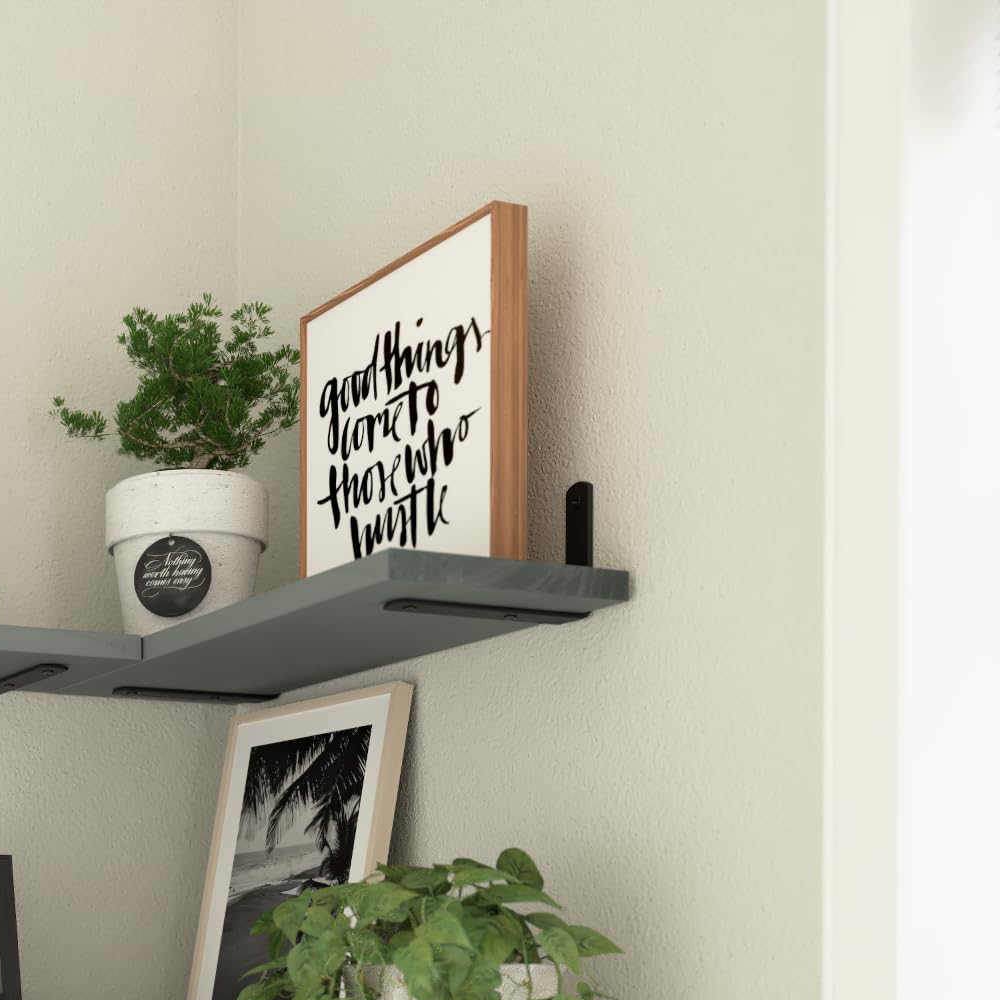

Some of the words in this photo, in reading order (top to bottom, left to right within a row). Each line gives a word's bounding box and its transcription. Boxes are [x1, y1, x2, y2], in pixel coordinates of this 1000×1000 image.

[320, 333, 380, 455] good
[379, 317, 491, 395] things
[317, 454, 401, 529] those
[405, 407, 482, 484] who
[341, 401, 404, 461] come
[350, 478, 450, 560] hustle
[142, 565, 171, 579] worth
[171, 564, 204, 581] having
